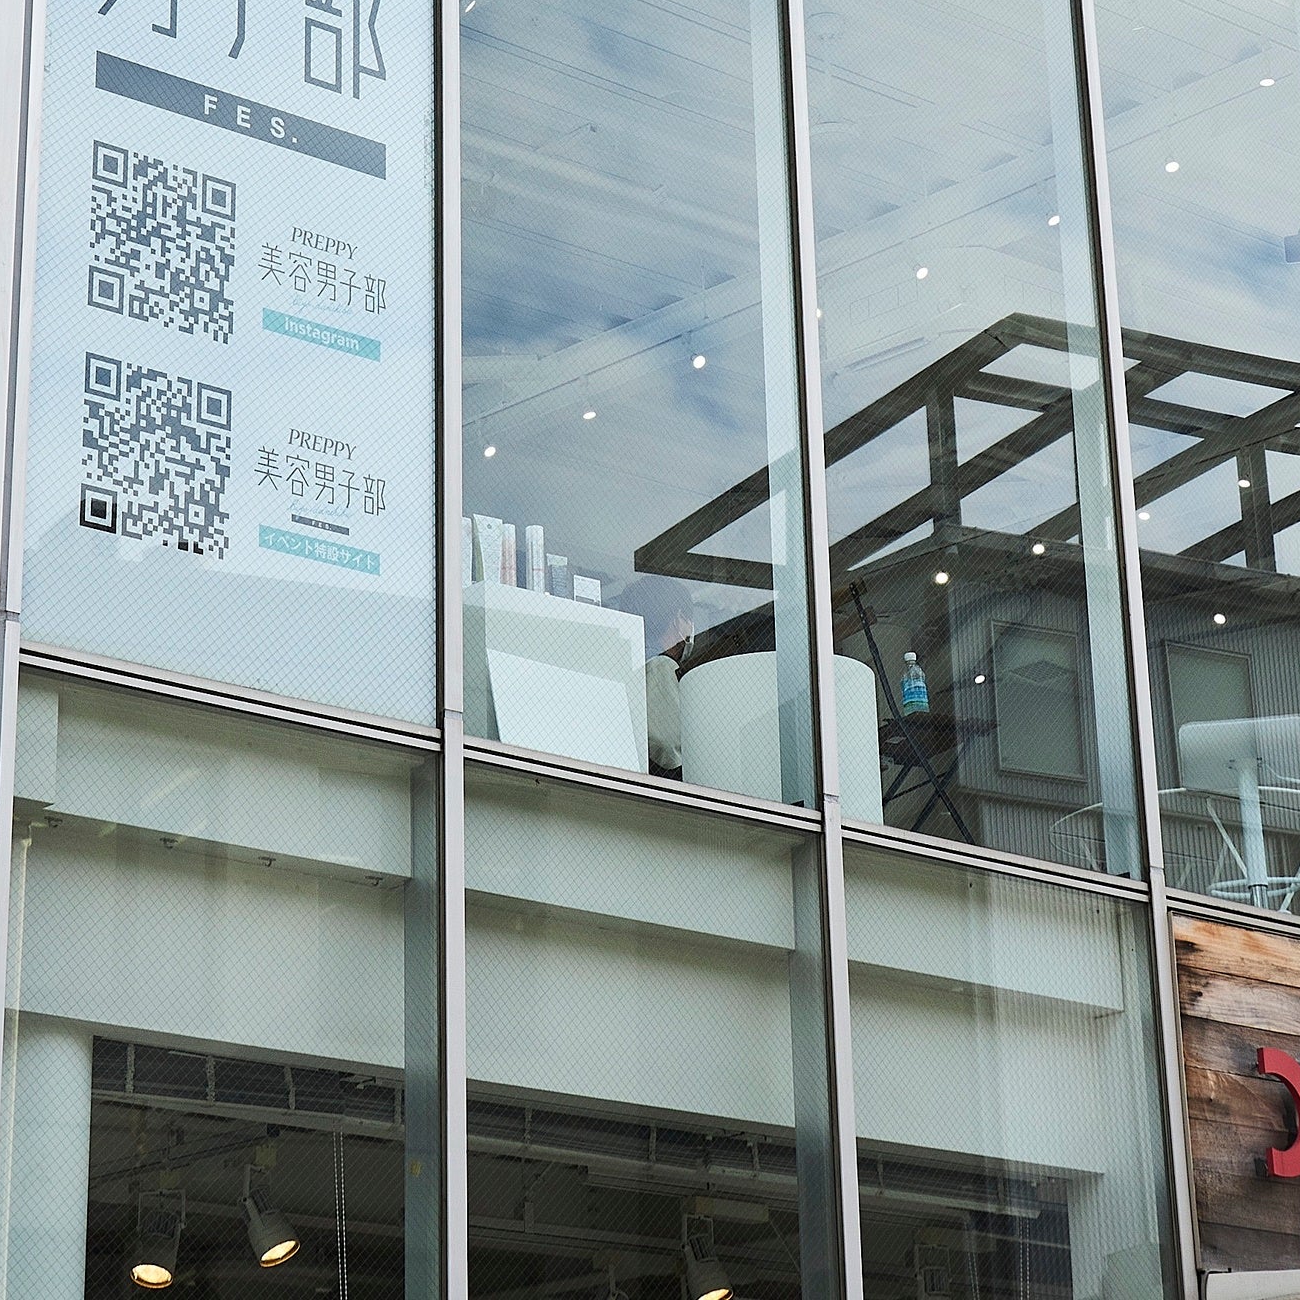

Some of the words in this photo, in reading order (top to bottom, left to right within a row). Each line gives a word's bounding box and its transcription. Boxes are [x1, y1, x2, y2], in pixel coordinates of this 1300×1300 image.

[203, 94, 299, 143] FES.
[290, 226, 358, 260] PREPPY
[257, 242, 387, 315] 美容男子部
[288, 428, 357, 461] PREPPY
[254, 445, 386, 516] 美容男子部
[264, 532, 375, 570] イベント特設サイト
